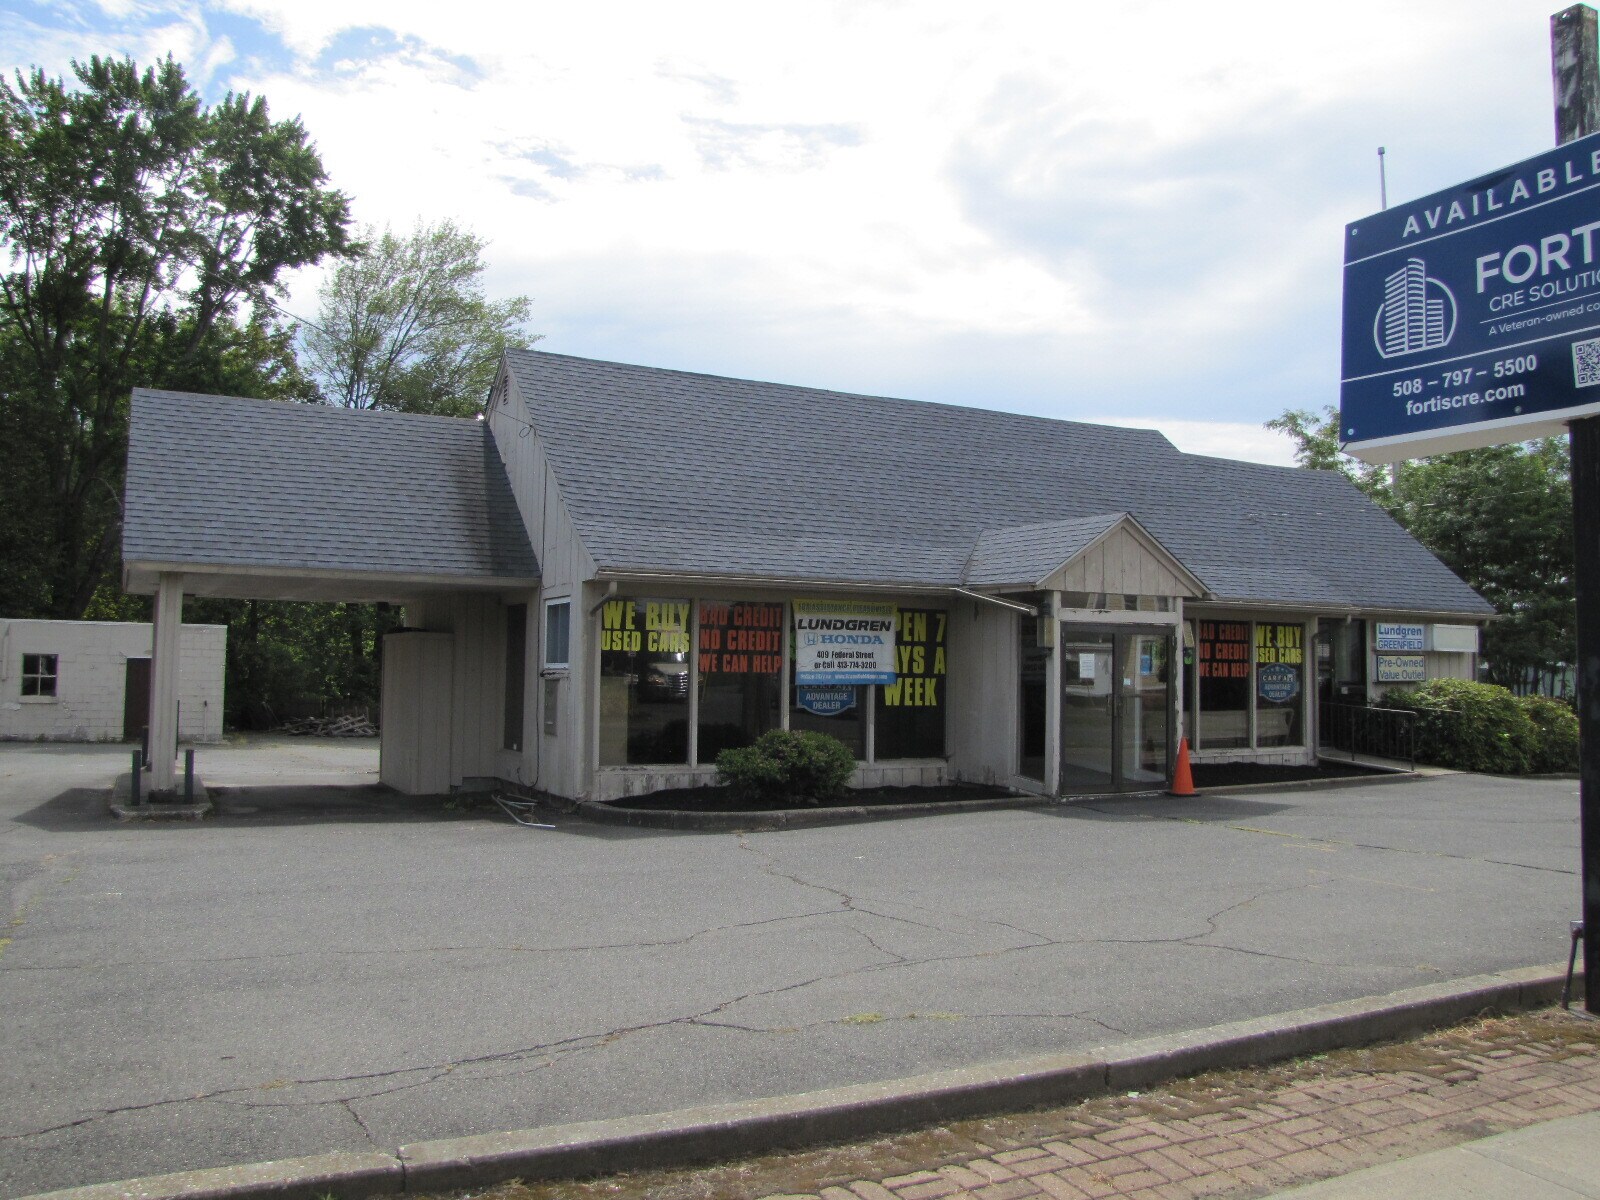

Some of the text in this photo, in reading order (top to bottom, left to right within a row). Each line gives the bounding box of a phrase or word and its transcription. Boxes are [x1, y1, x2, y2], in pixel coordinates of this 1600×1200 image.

[1402, 149, 1600, 237] AVAILABLE
[1476, 221, 1600, 293] FORT
[1489, 290, 1525, 312] CRE
[1488, 326, 1498, 336] A
[1498, 304, 1585, 333] Veteran-owned
[1392, 378, 1422, 397] 508
[1442, 367, 1473, 388] 797
[1493, 354, 1538, 378] 5500
[1406, 383, 1525, 416] fortiscre.com
[602, 601, 691, 631] WE BUY
[699, 605, 729, 625] BAD
[733, 606, 782, 627] CREDIT
[797, 618, 892, 632] LUNDGREN
[936, 613, 946, 642] 7
[1219, 624, 1249, 640] CREDIT
[1277, 626, 1301, 647] BUY
[1378, 624, 1422, 638] Lundgren
[601, 630, 690, 653] USED CARS
[699, 629, 781, 651] NO CREDIT
[820, 634, 884, 645] HONDA
[1378, 640, 1423, 650] GREENFIELD
[816, 651, 874, 659] 409 Federal Street
[934, 646, 945, 674] A
[1216, 643, 1248, 659] CREDIT
[1278, 647, 1302, 663] CARS
[699, 653, 782, 673] WE CAN HELP
[822, 661, 835, 669] Call
[836, 661, 877, 669] 413-774-3200
[1213, 662, 1229, 677] CAN
[1231, 662, 1250, 677] HELP
[1378, 657, 1424, 668] Pre-Owned
[1378, 669, 1425, 680] Value Outlet
[805, 692, 848, 701] ADVANTAGE
[884, 677, 937, 706] WEEK
[812, 701, 841, 710] DEALER
